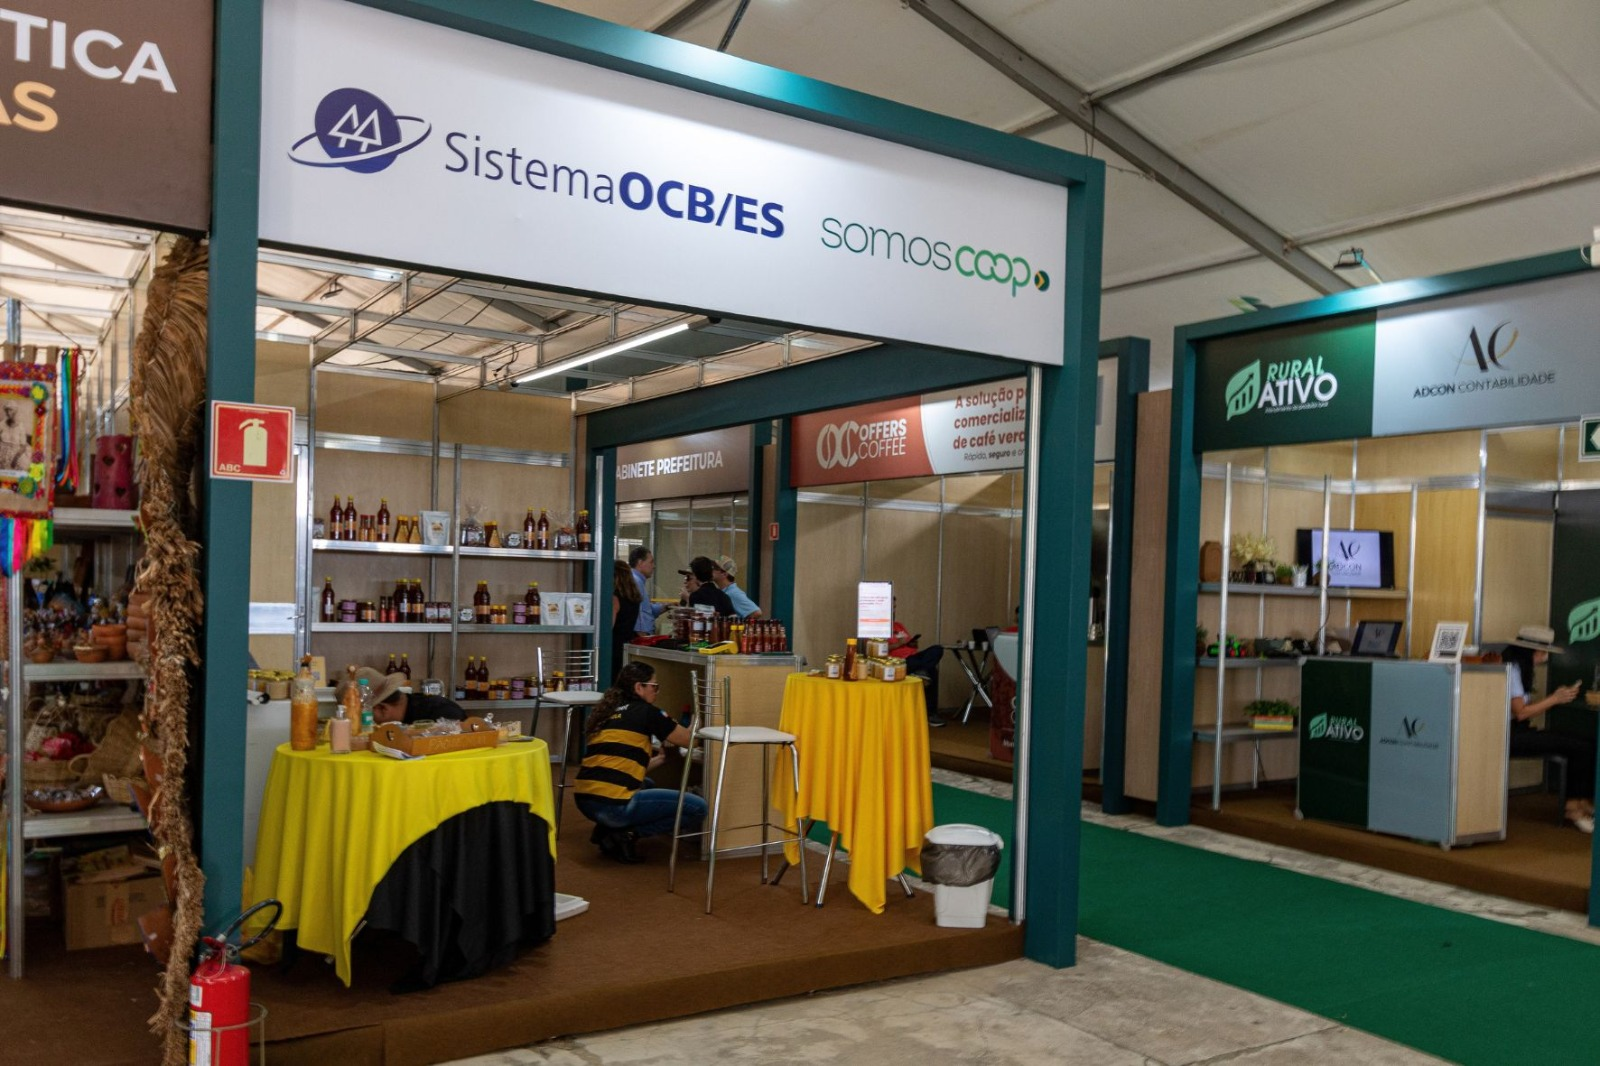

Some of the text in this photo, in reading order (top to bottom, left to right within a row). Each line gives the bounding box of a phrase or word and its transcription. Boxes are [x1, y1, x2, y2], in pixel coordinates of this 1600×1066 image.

[0, 8, 178, 93] TICA
[0, 81, 58, 132] S
[1267, 355, 1325, 382] RURAL
[1258, 372, 1338, 409] ATIVO
[1413, 373, 1556, 399] ADCON CONTABILIDADE
[955, 387, 1027, 409] A solução p
[859, 419, 907, 441] OFFERS
[953, 435, 967, 449] de
[969, 430, 996, 447] café
[859, 437, 907, 459] COFFEE
[988, 449, 1010, 459] seguro
[219, 463, 241, 473] ABC
[657, 450, 724, 475] PREFEITURA
[1326, 722, 1364, 740] ATIVO
